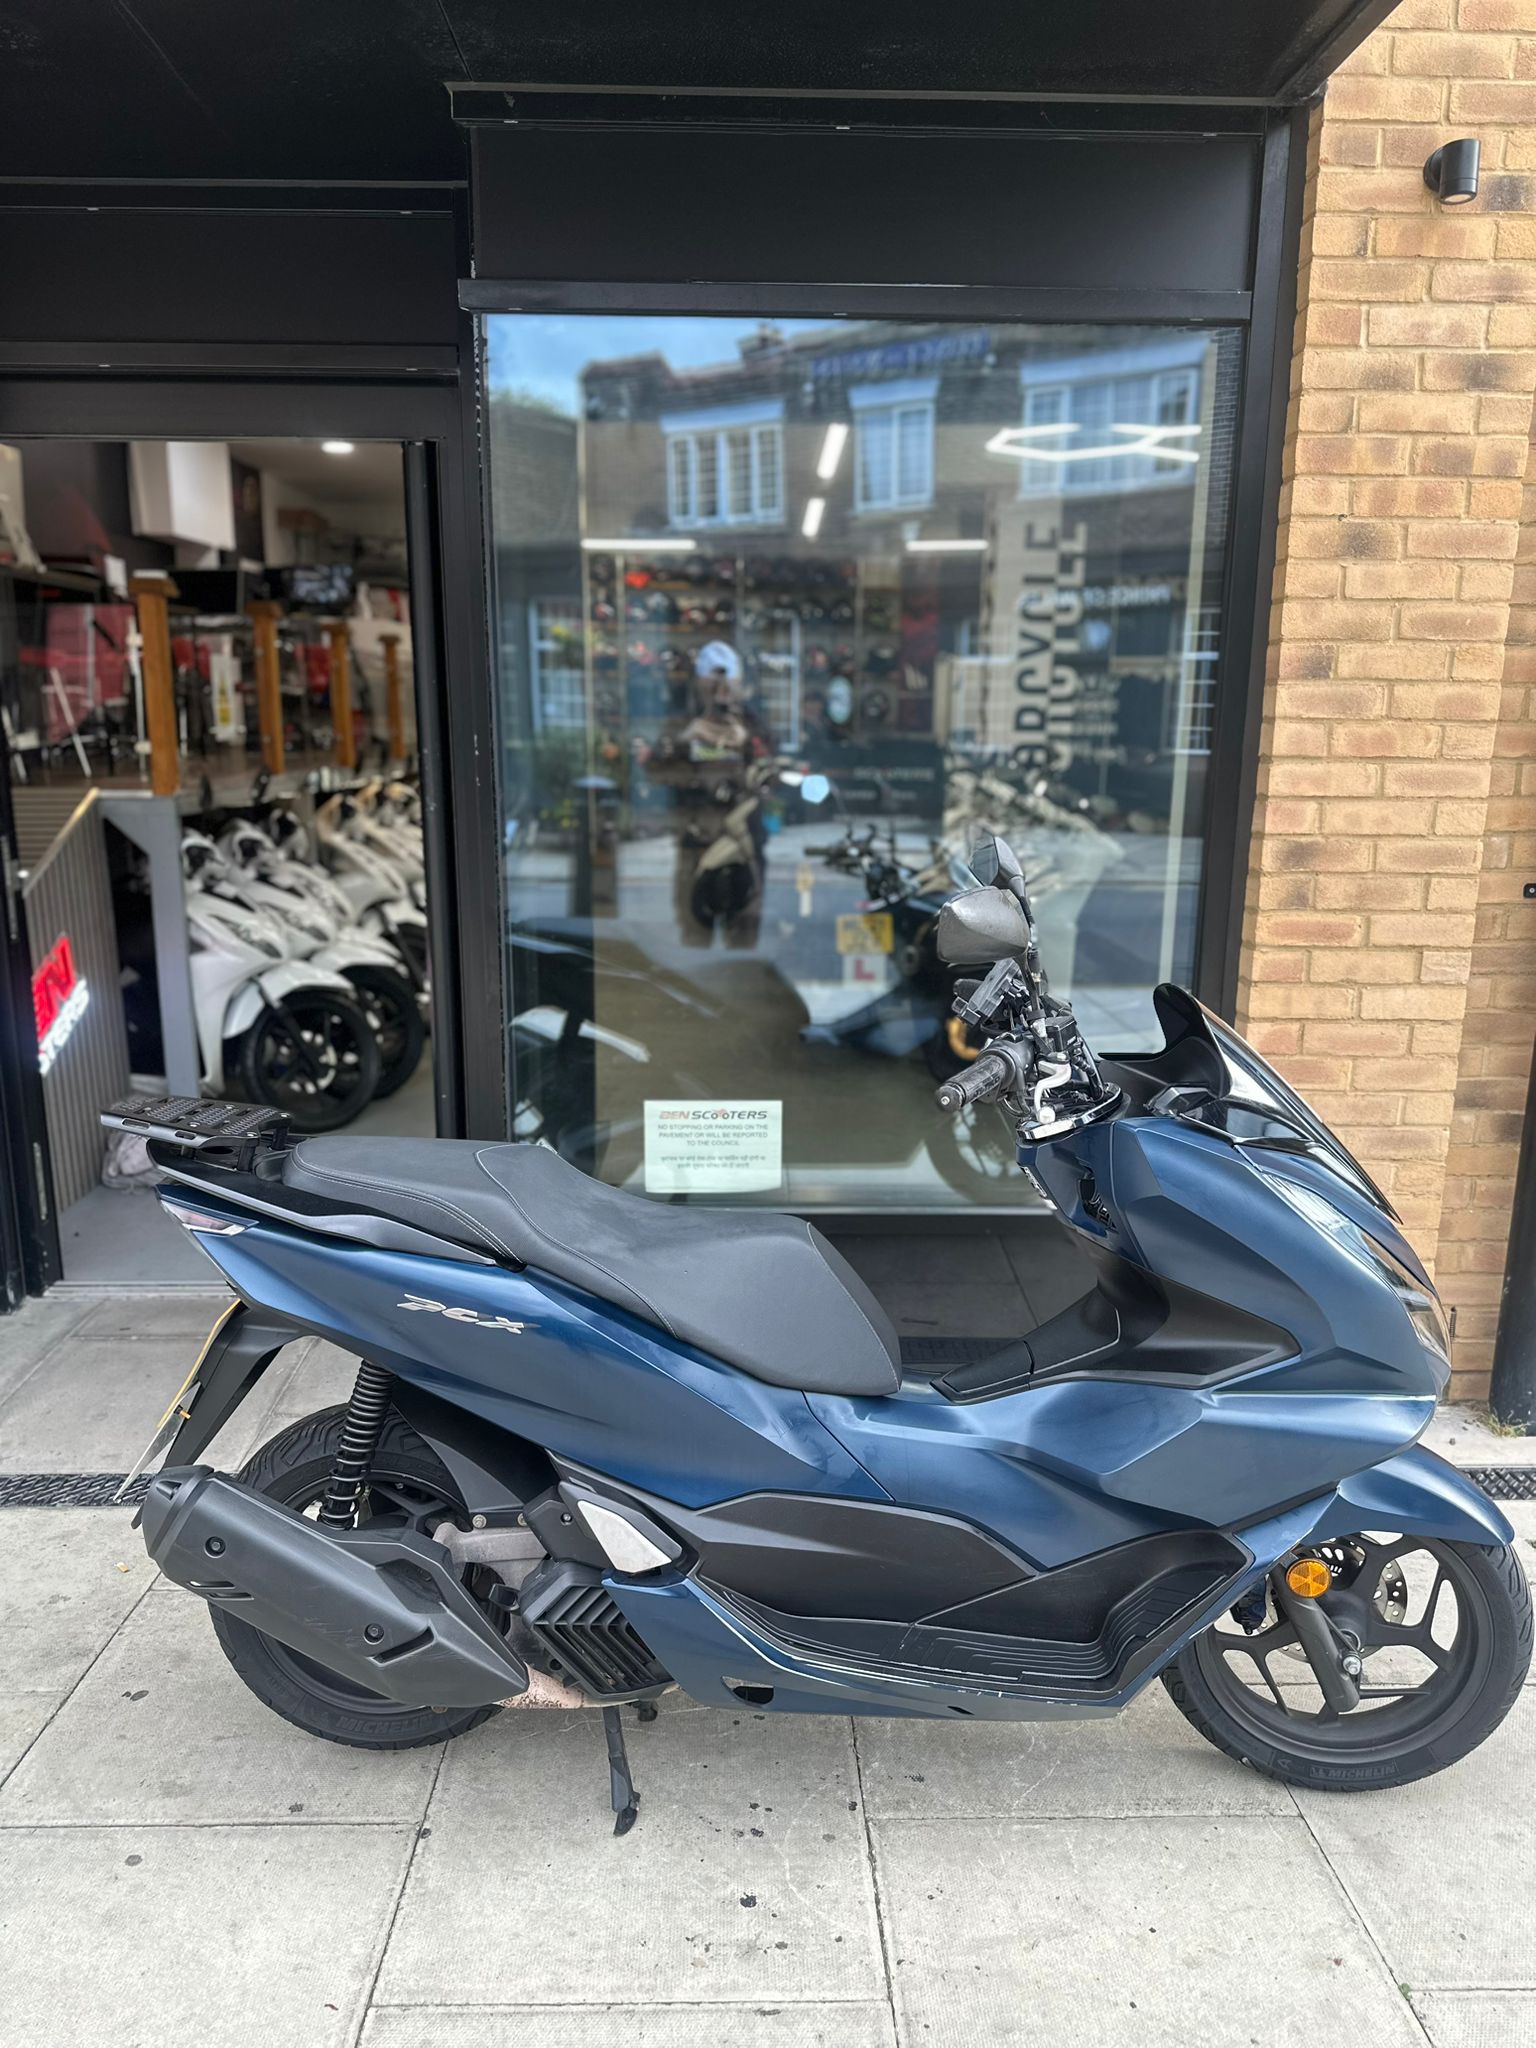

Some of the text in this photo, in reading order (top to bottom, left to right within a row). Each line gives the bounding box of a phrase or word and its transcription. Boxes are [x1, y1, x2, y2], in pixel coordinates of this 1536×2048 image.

[854, 959, 876, 981] L
[397, 1293, 541, 1334] PCX
[1327, 1764, 1397, 1778] MICHELIN
